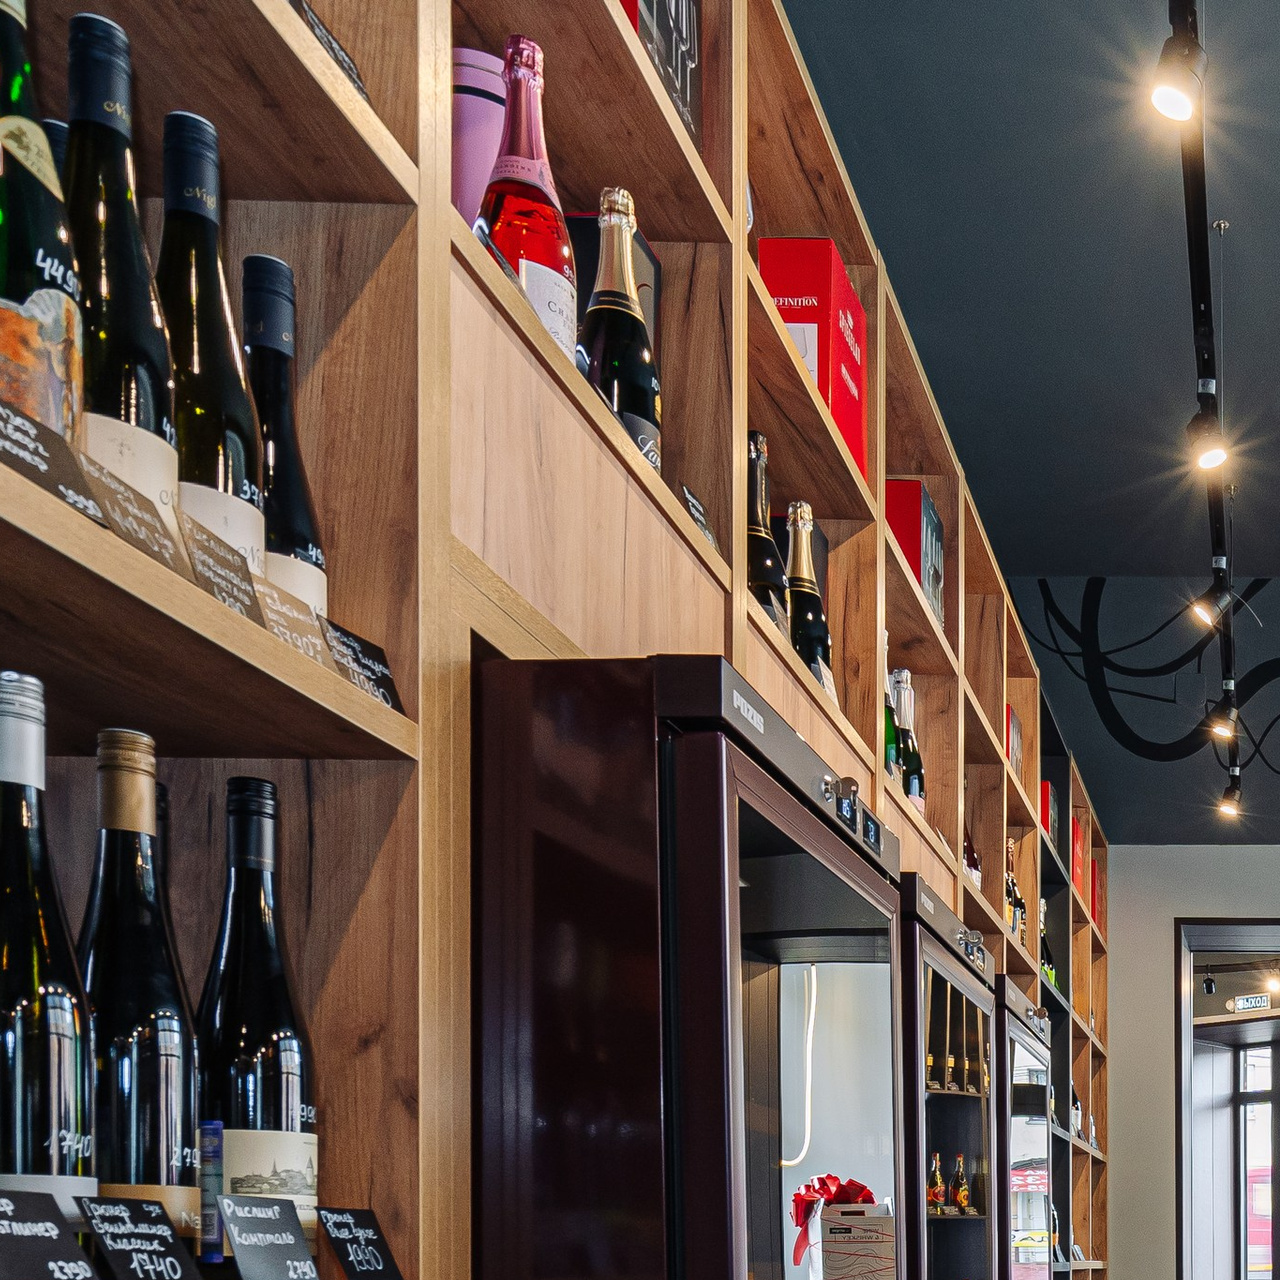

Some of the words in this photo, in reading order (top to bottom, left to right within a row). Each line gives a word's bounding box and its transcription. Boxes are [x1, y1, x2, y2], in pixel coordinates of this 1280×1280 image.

[772, 296, 819, 307] EFINITION
[223, 1198, 282, 1221] Рислинг
[129, 1251, 183, 1280] 1740
[347, 1242, 384, 1273] 1990
[285, 1260, 318, 1280] 2790
